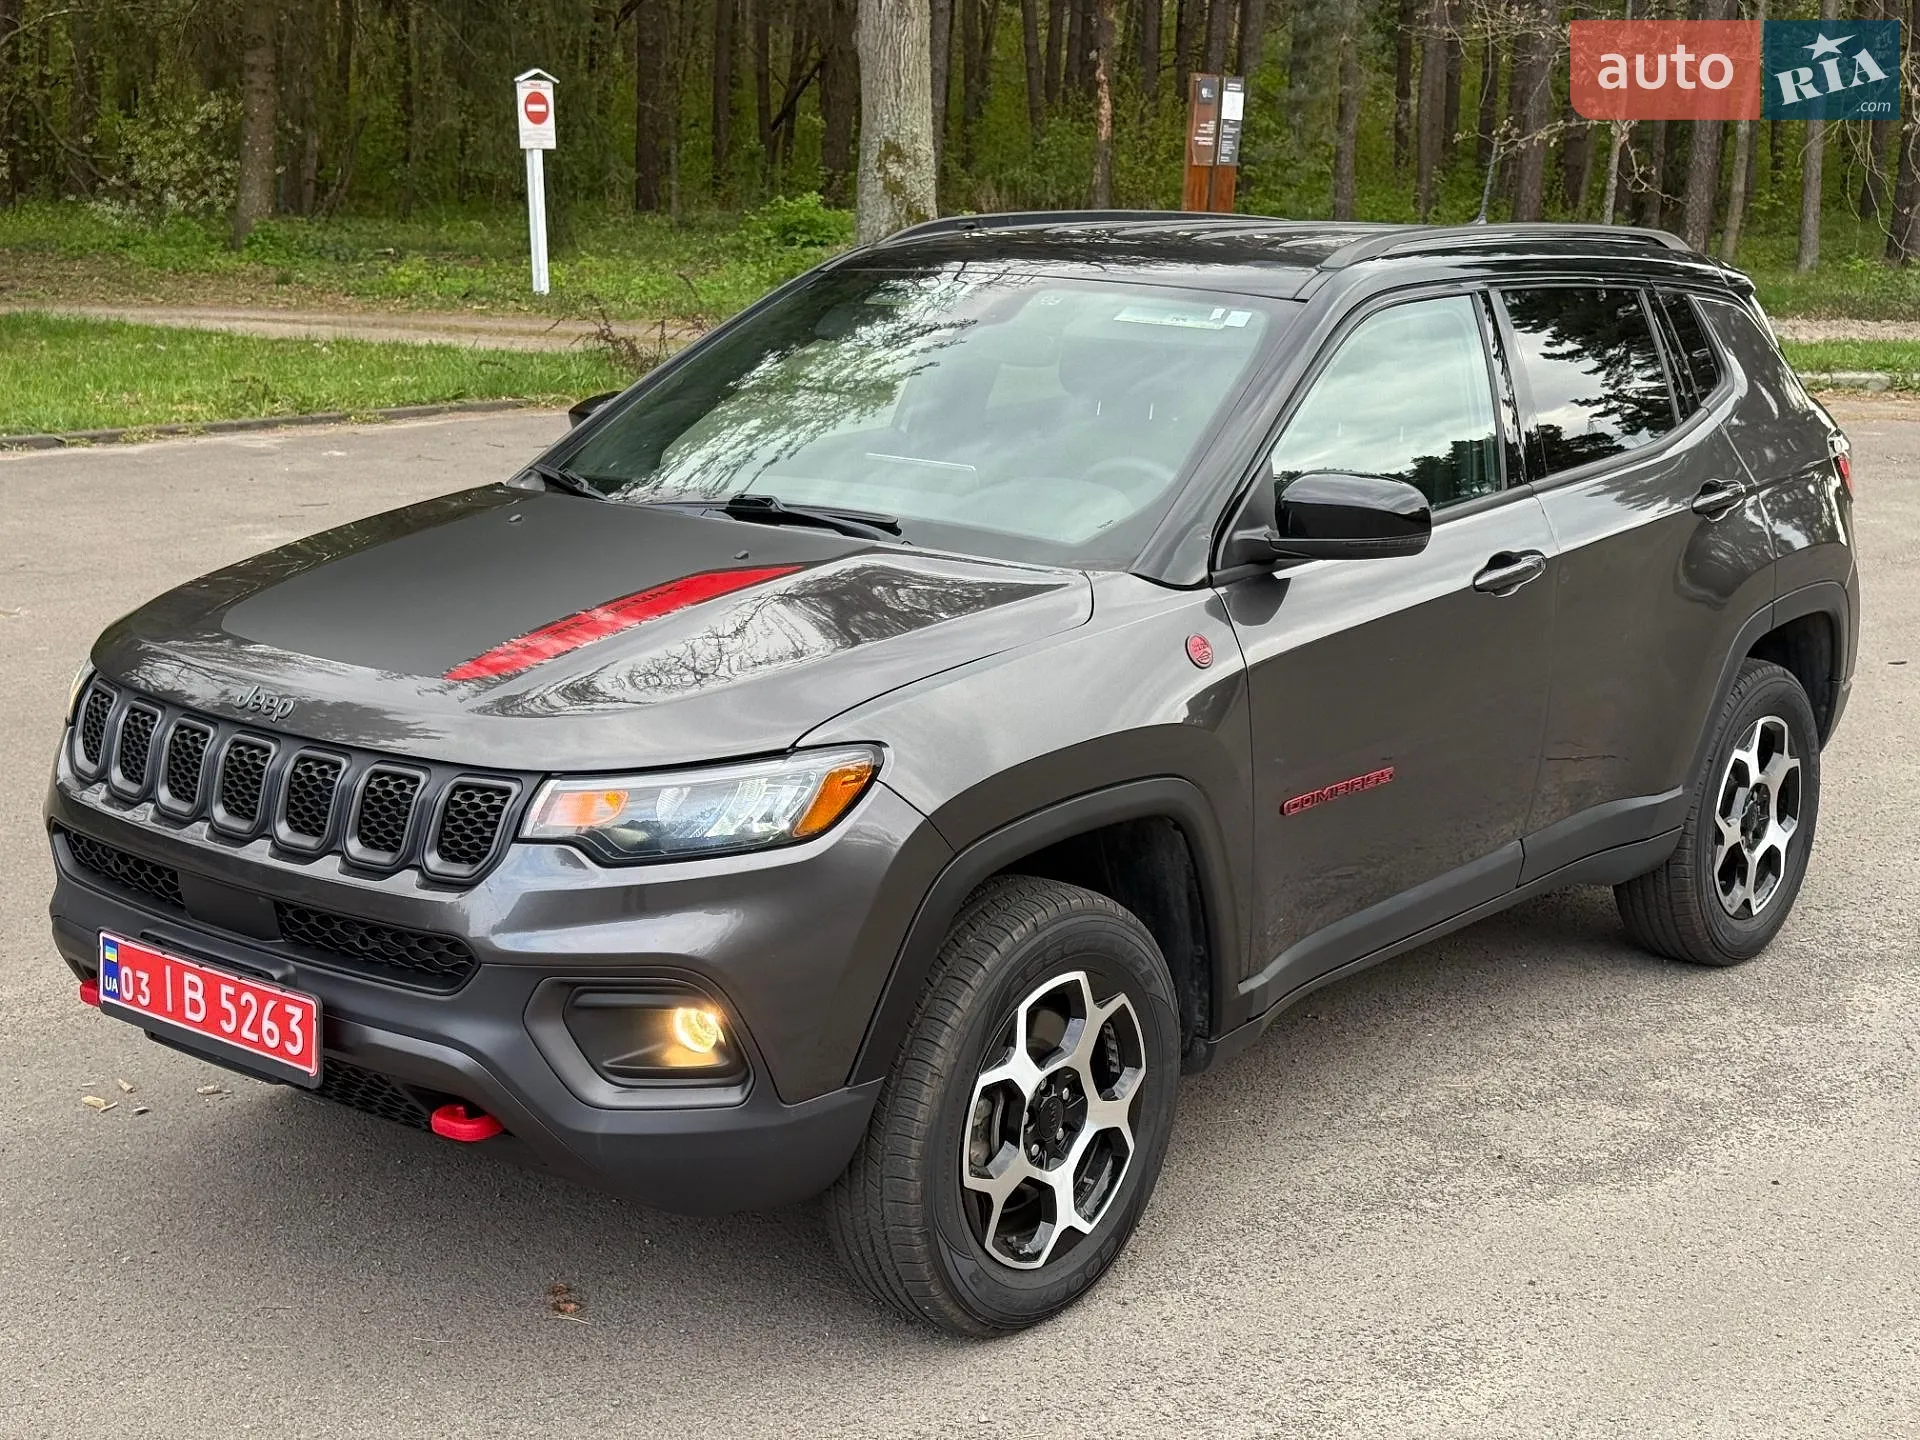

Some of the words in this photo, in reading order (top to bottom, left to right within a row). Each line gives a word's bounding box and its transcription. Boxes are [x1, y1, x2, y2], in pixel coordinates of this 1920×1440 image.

[232, 685, 296, 723] Jeep
[1282, 766, 1395, 816] COMPASS
[104, 977, 119, 994] UA
[120, 965, 151, 1007] 03
[219, 983, 304, 1056] 5263
